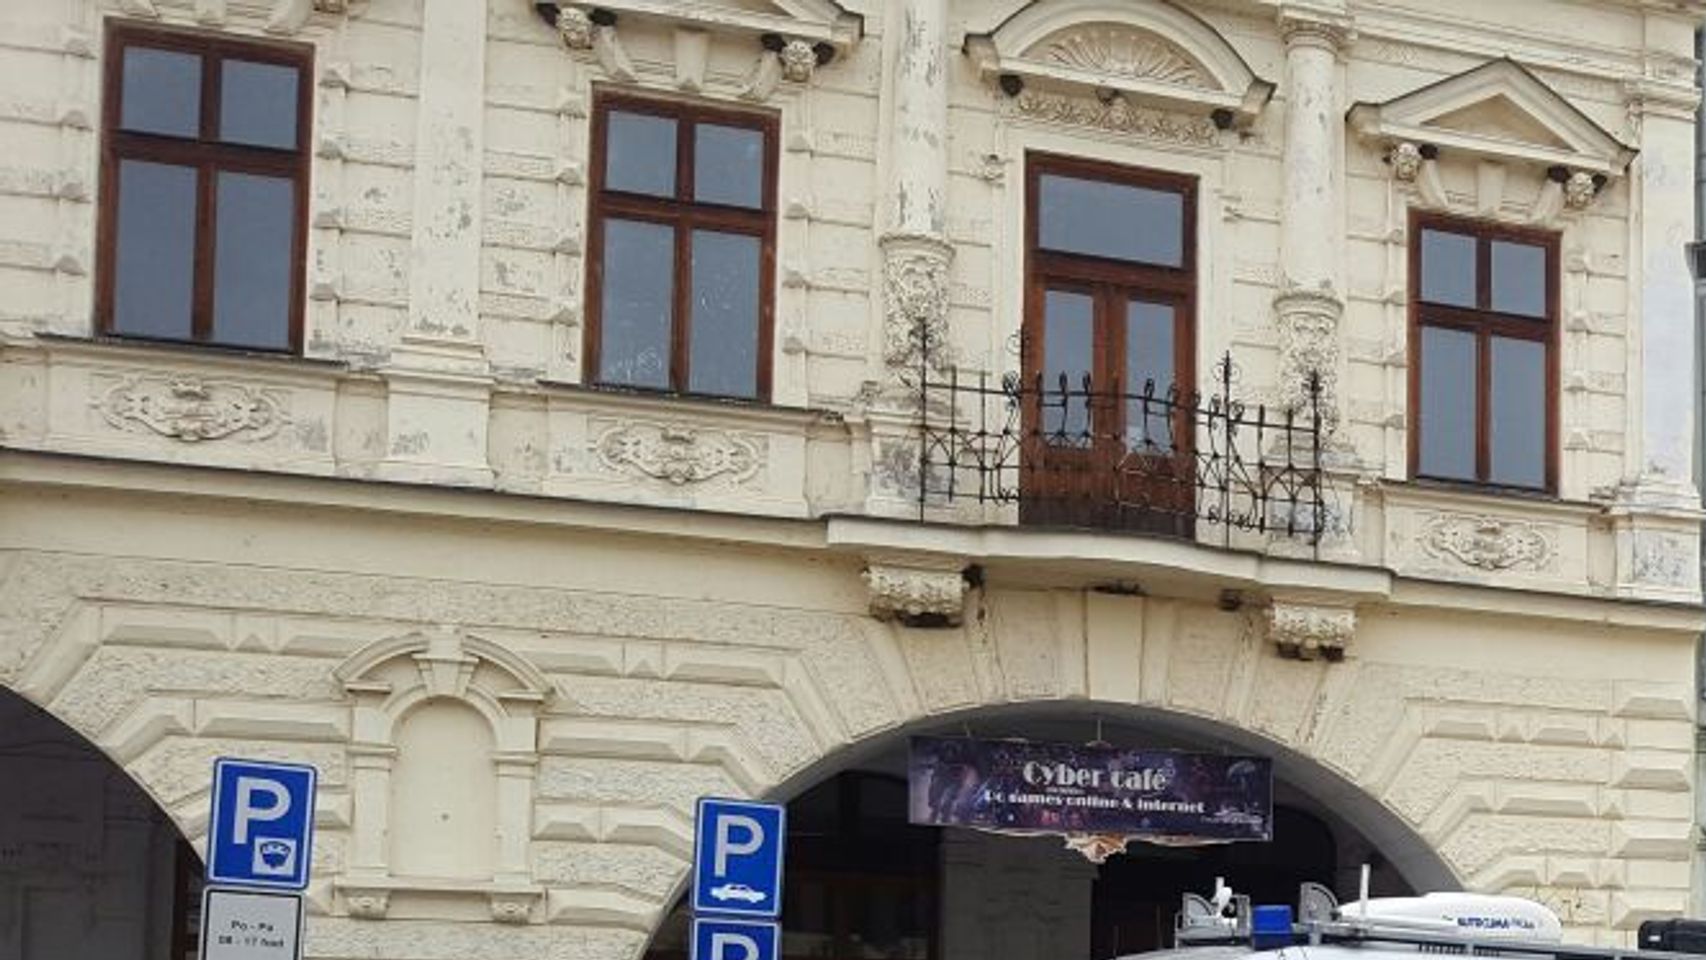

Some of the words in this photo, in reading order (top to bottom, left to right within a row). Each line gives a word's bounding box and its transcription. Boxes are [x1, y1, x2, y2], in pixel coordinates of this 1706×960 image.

[1023, 760, 1104, 789] Cyber
[1109, 766, 1168, 791] café
[233, 776, 292, 845] P
[1066, 794, 1120, 809] online
[714, 814, 765, 878] P
